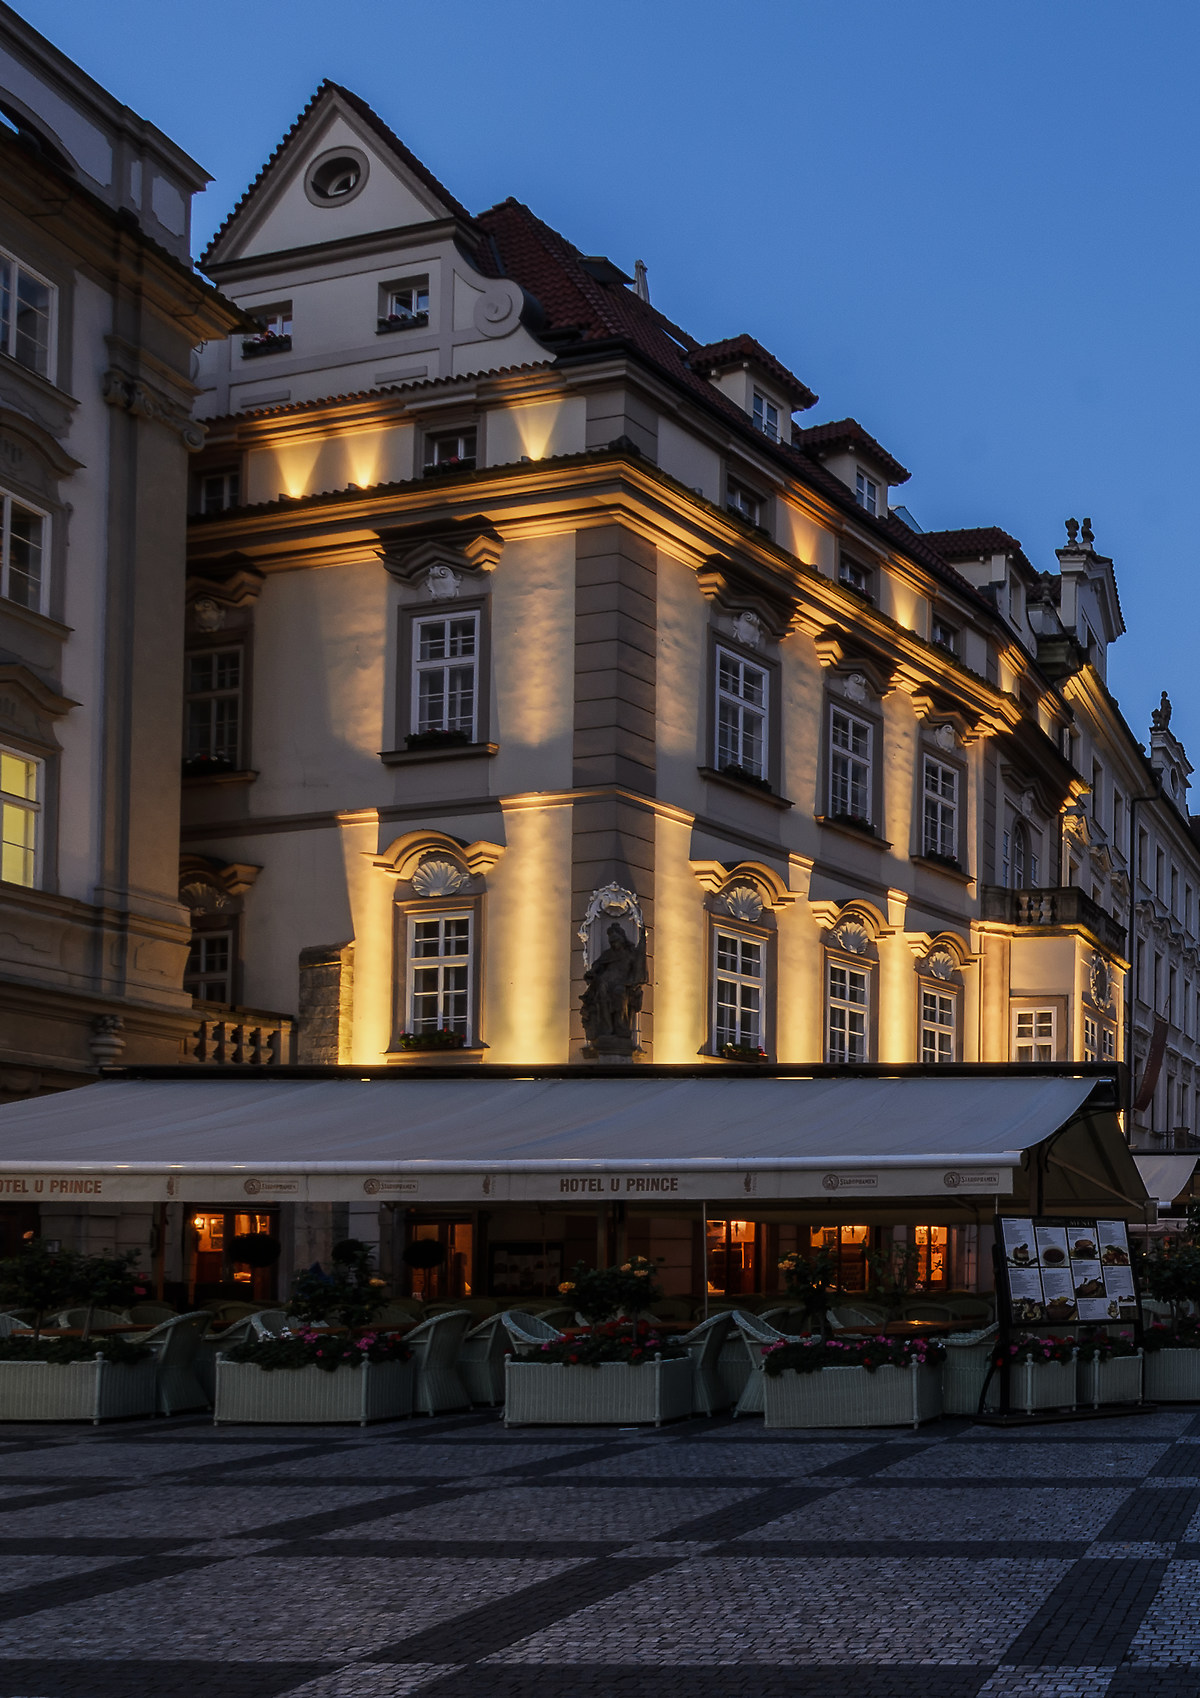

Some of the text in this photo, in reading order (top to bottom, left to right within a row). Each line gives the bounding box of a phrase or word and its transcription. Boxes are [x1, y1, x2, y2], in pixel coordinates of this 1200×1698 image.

[34, 1180, 43, 1192] U
[50, 1180, 102, 1193] PRINCE
[560, 1177, 678, 1192] HOTEL U PRINCE
